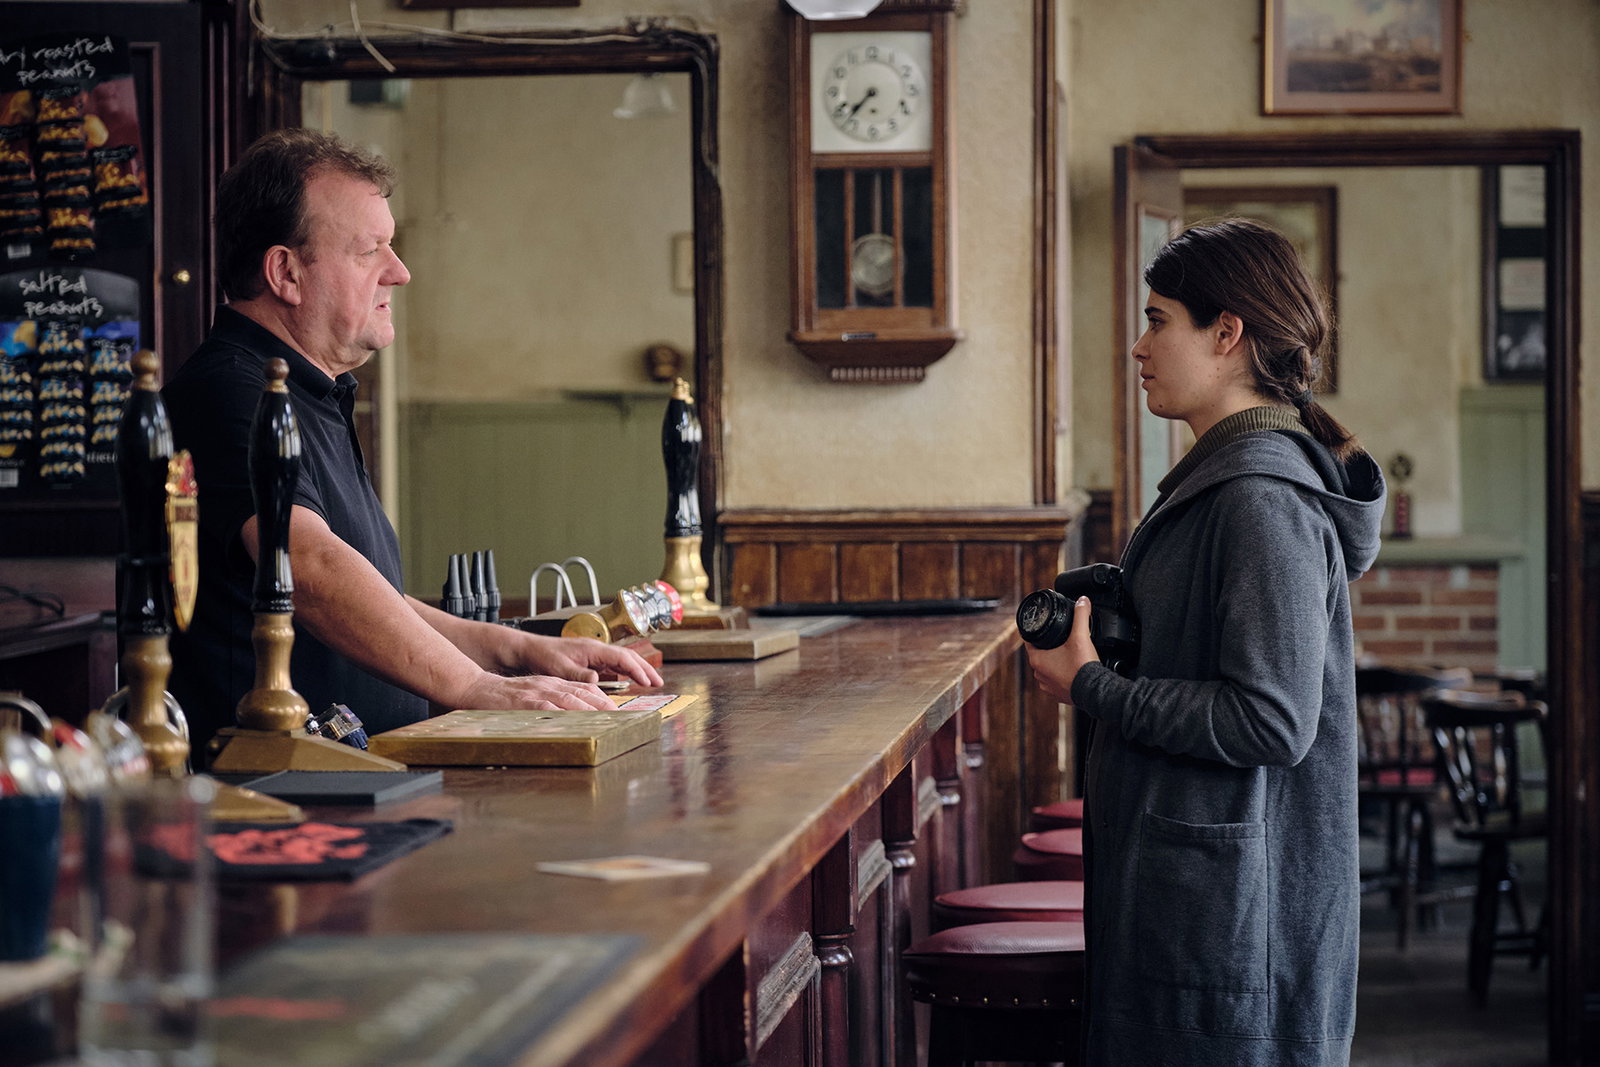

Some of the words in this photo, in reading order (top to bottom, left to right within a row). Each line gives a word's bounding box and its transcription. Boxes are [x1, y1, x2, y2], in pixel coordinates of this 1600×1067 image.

[32, 36, 114, 59] roasted
[17, 59, 96, 86] peanuts
[18, 270, 88, 296] salted
[23, 296, 104, 319] peanuts
